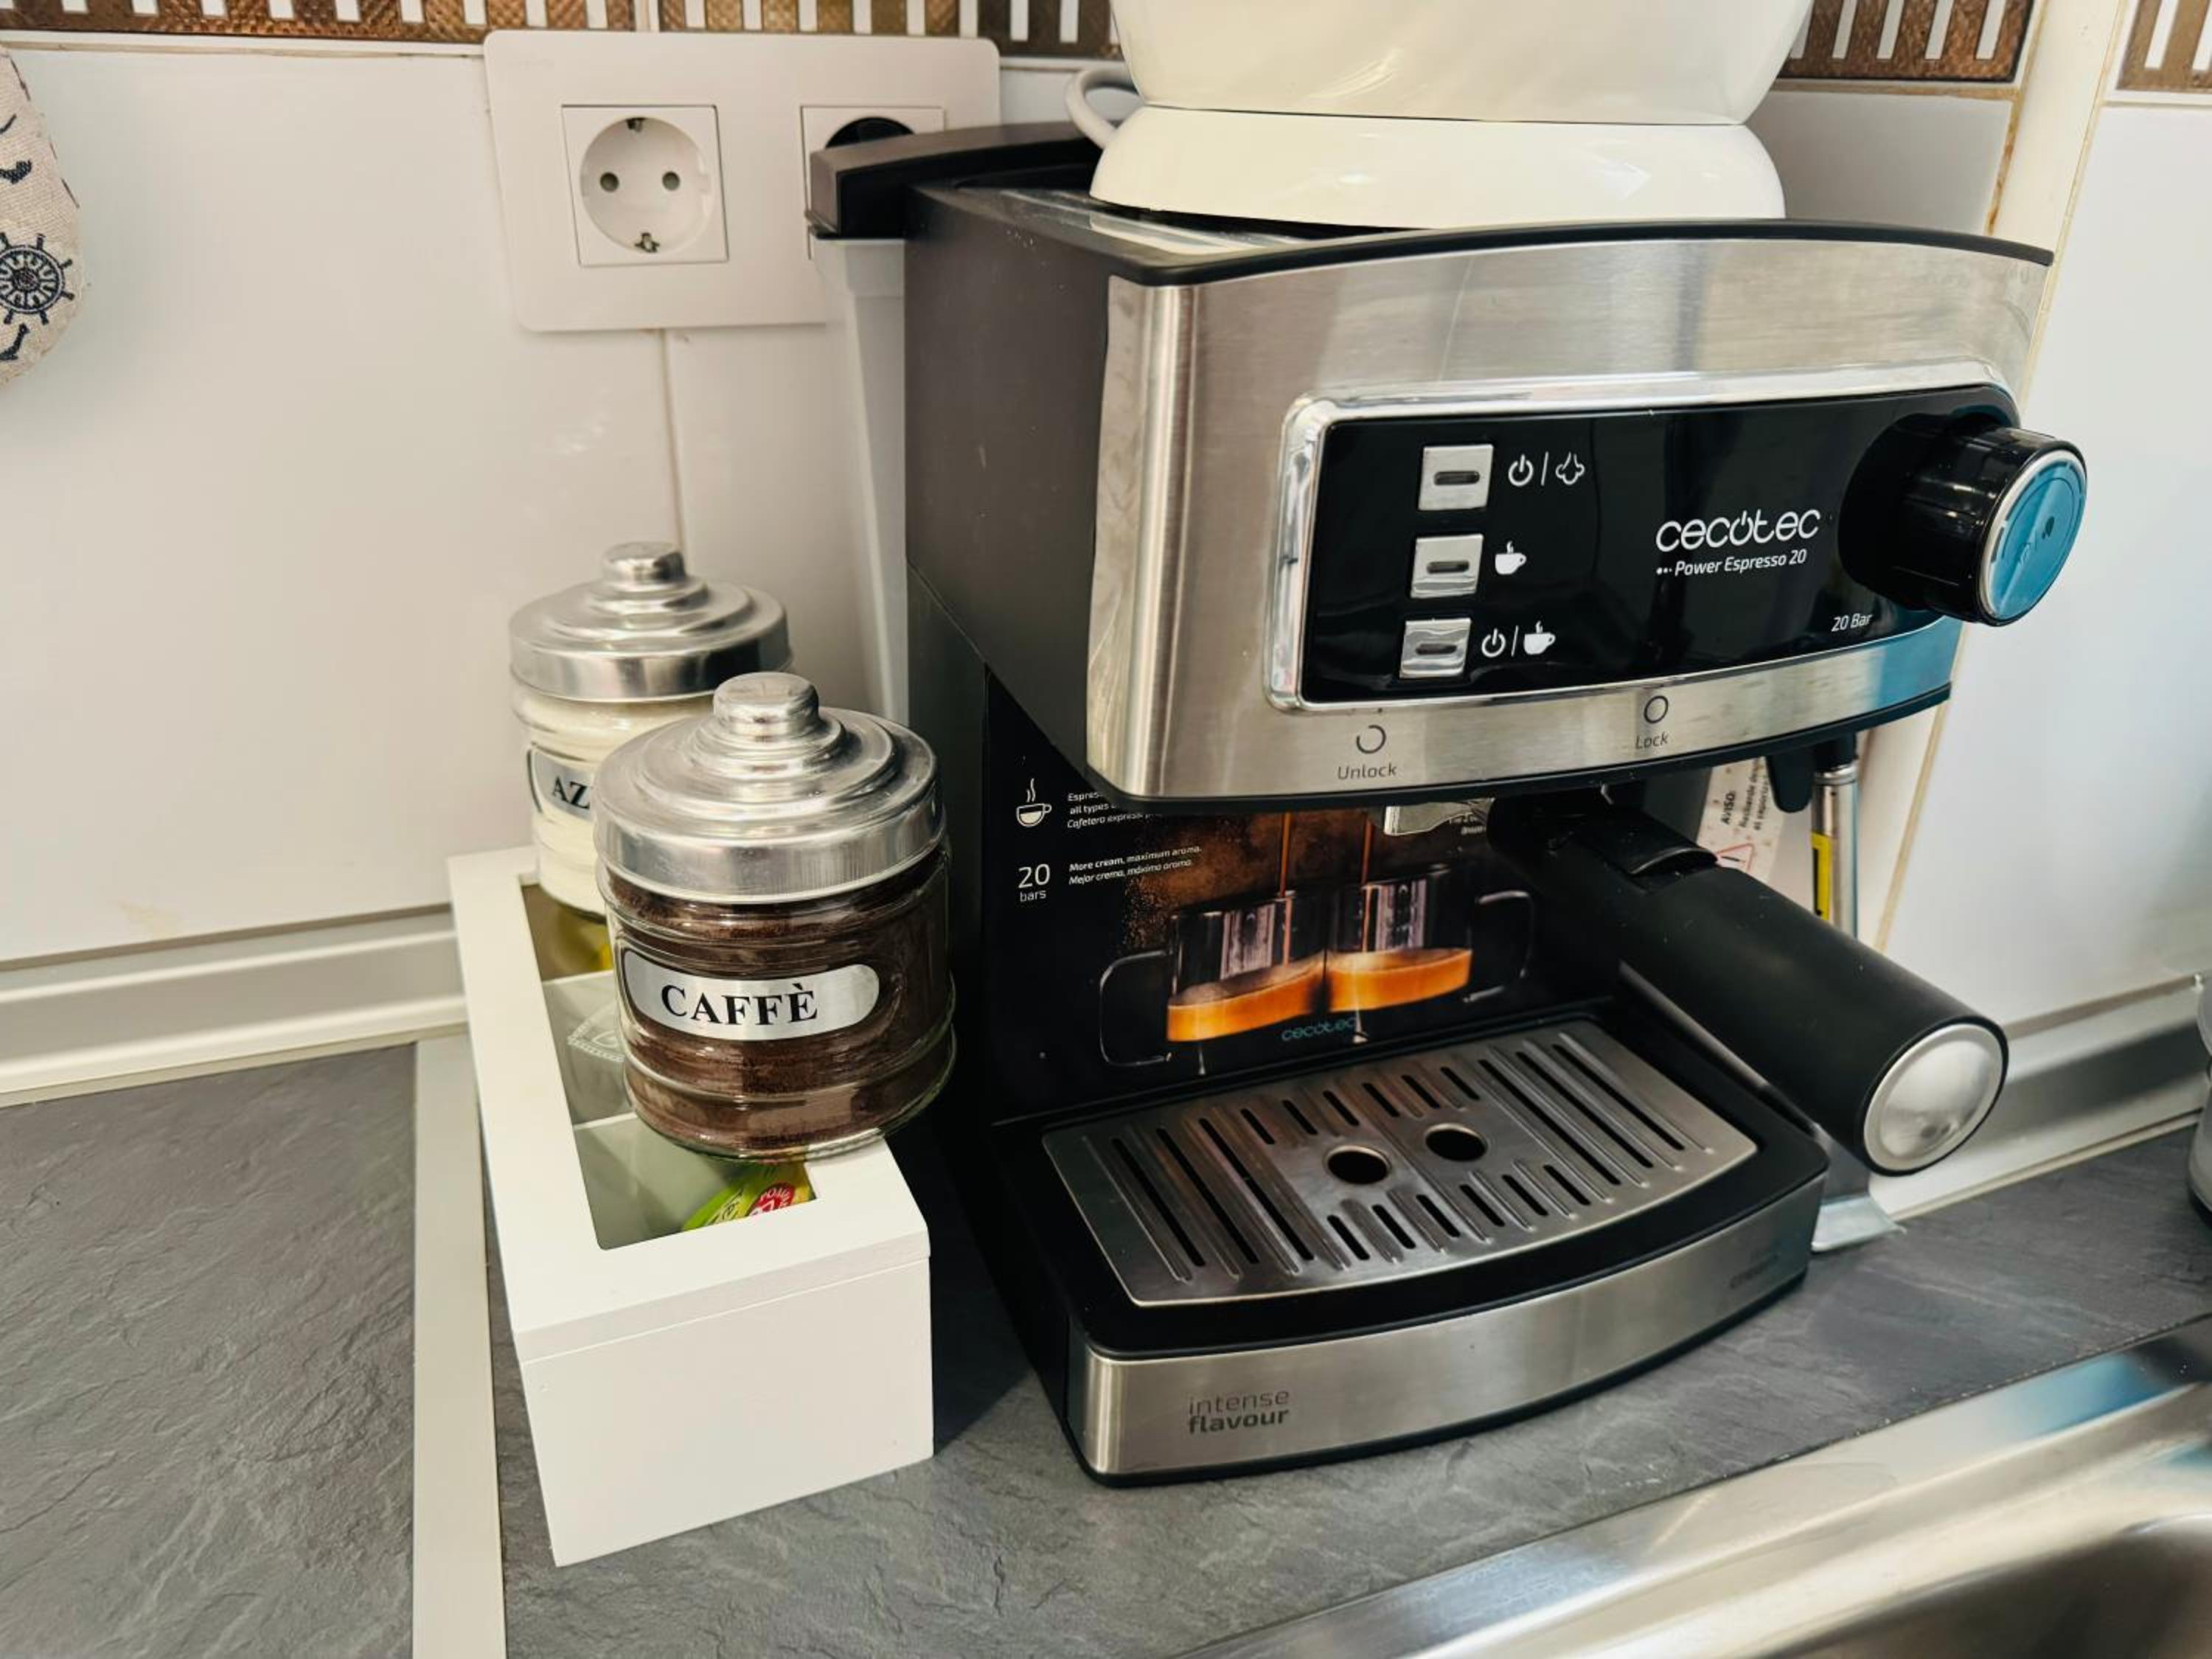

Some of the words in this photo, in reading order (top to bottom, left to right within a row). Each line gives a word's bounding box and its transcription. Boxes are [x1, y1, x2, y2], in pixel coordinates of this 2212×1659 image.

[1656, 509, 1820, 552] cecotec
[1674, 560, 1722, 577] Power
[1724, 554, 1787, 573] Espresso
[1788, 549, 1807, 565] 20
[1831, 615, 1849, 632] 20
[1850, 613, 1873, 629] Bar
[1635, 731, 1669, 750] Lock
[1338, 762, 1397, 780] Unlock
[1070, 807, 1082, 815] all
[1083, 802, 1109, 814] types
[1069, 862, 1093, 872] More
[1095, 857, 1125, 867] cream,
[1127, 849, 1170, 863] maximum
[1018, 863, 1051, 888] 20
[1069, 874, 1094, 886] Mejor
[1020, 889, 1047, 902] bars
[661, 983, 818, 1025] CAFFÈ
[1189, 1390, 1290, 1416] intense
[1189, 1409, 1290, 1433] flavour
